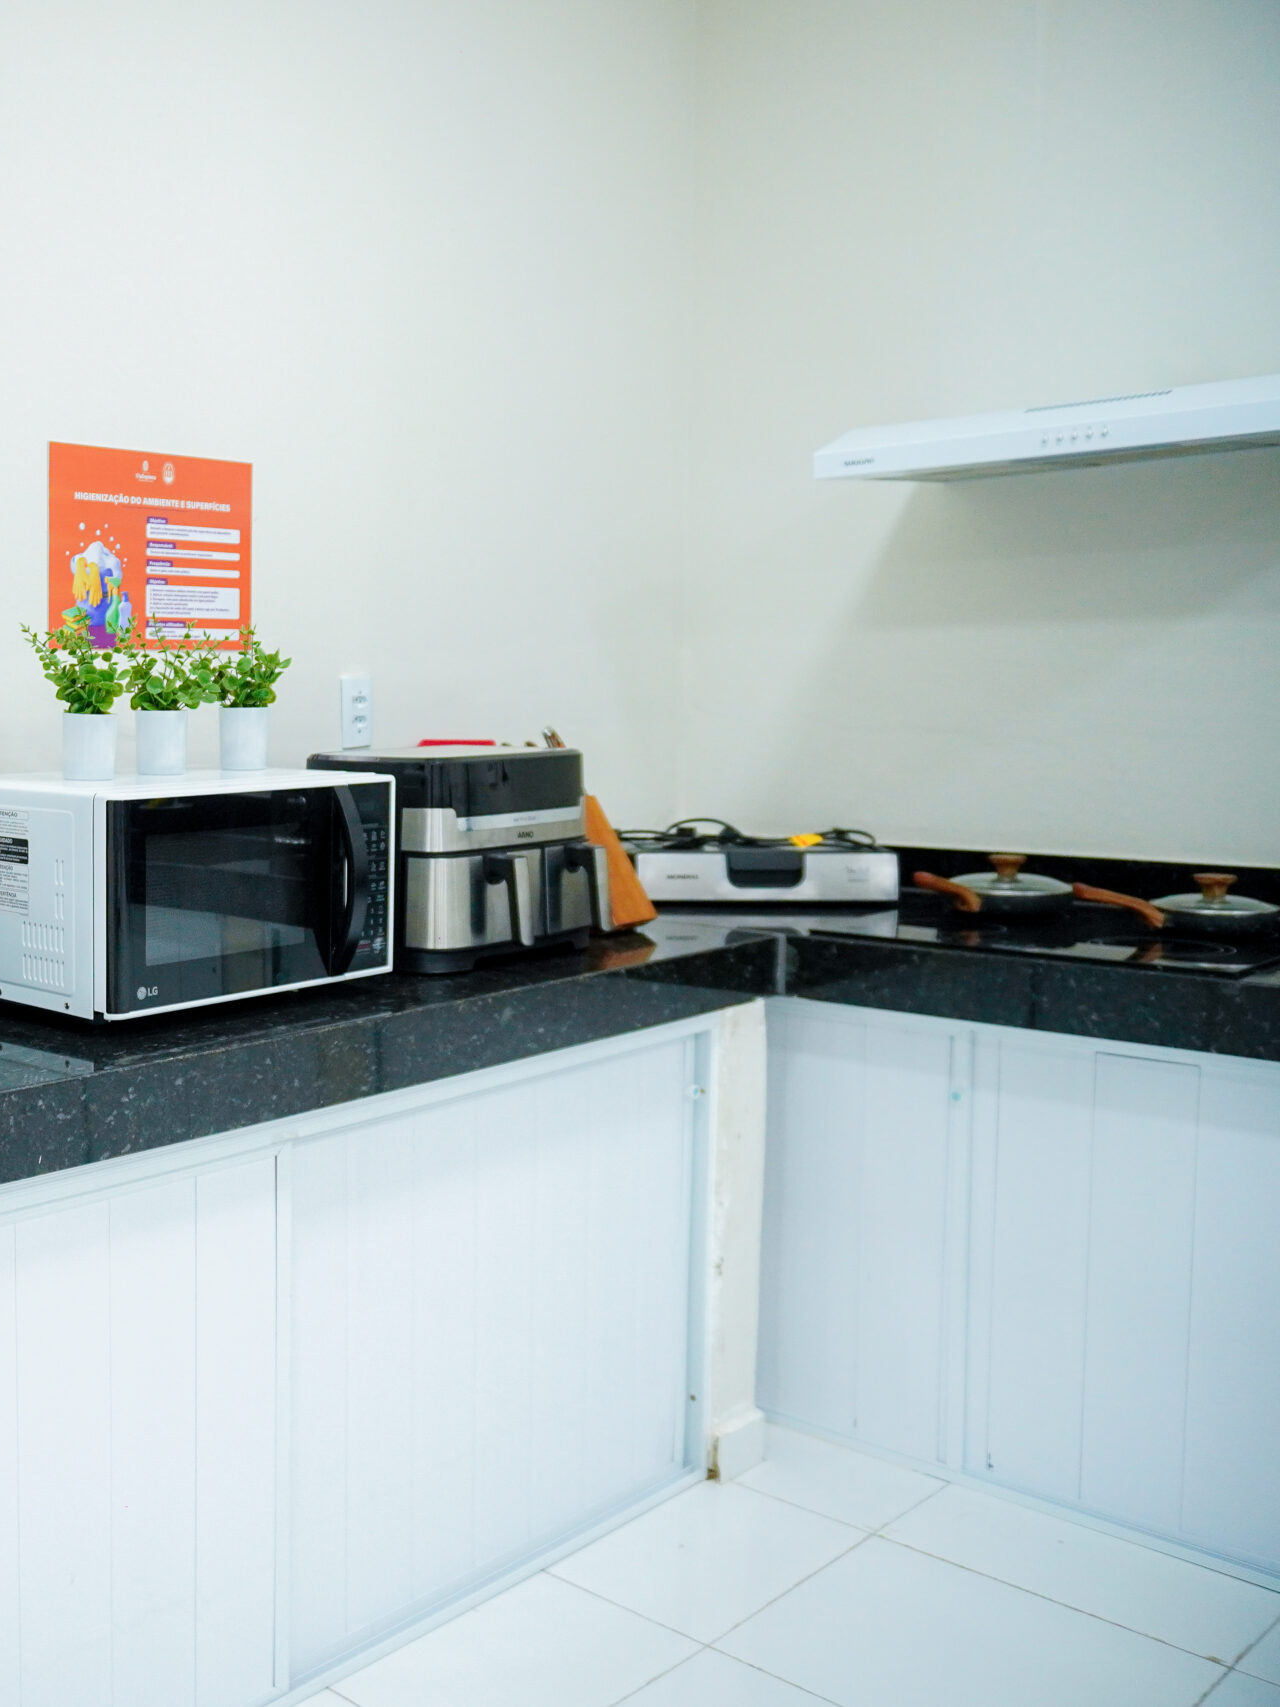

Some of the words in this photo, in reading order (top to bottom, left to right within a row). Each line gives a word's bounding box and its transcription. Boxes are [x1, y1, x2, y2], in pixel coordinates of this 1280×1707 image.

[74, 491, 129, 505] HIGIENIZAÇÃO
[130, 495, 141, 505] DO
[142, 497, 179, 508] AMBIENTE
[180, 500, 185, 508] E
[186, 500, 231, 512] SUPERFÍCIES
[147, 986, 159, 996] LG
